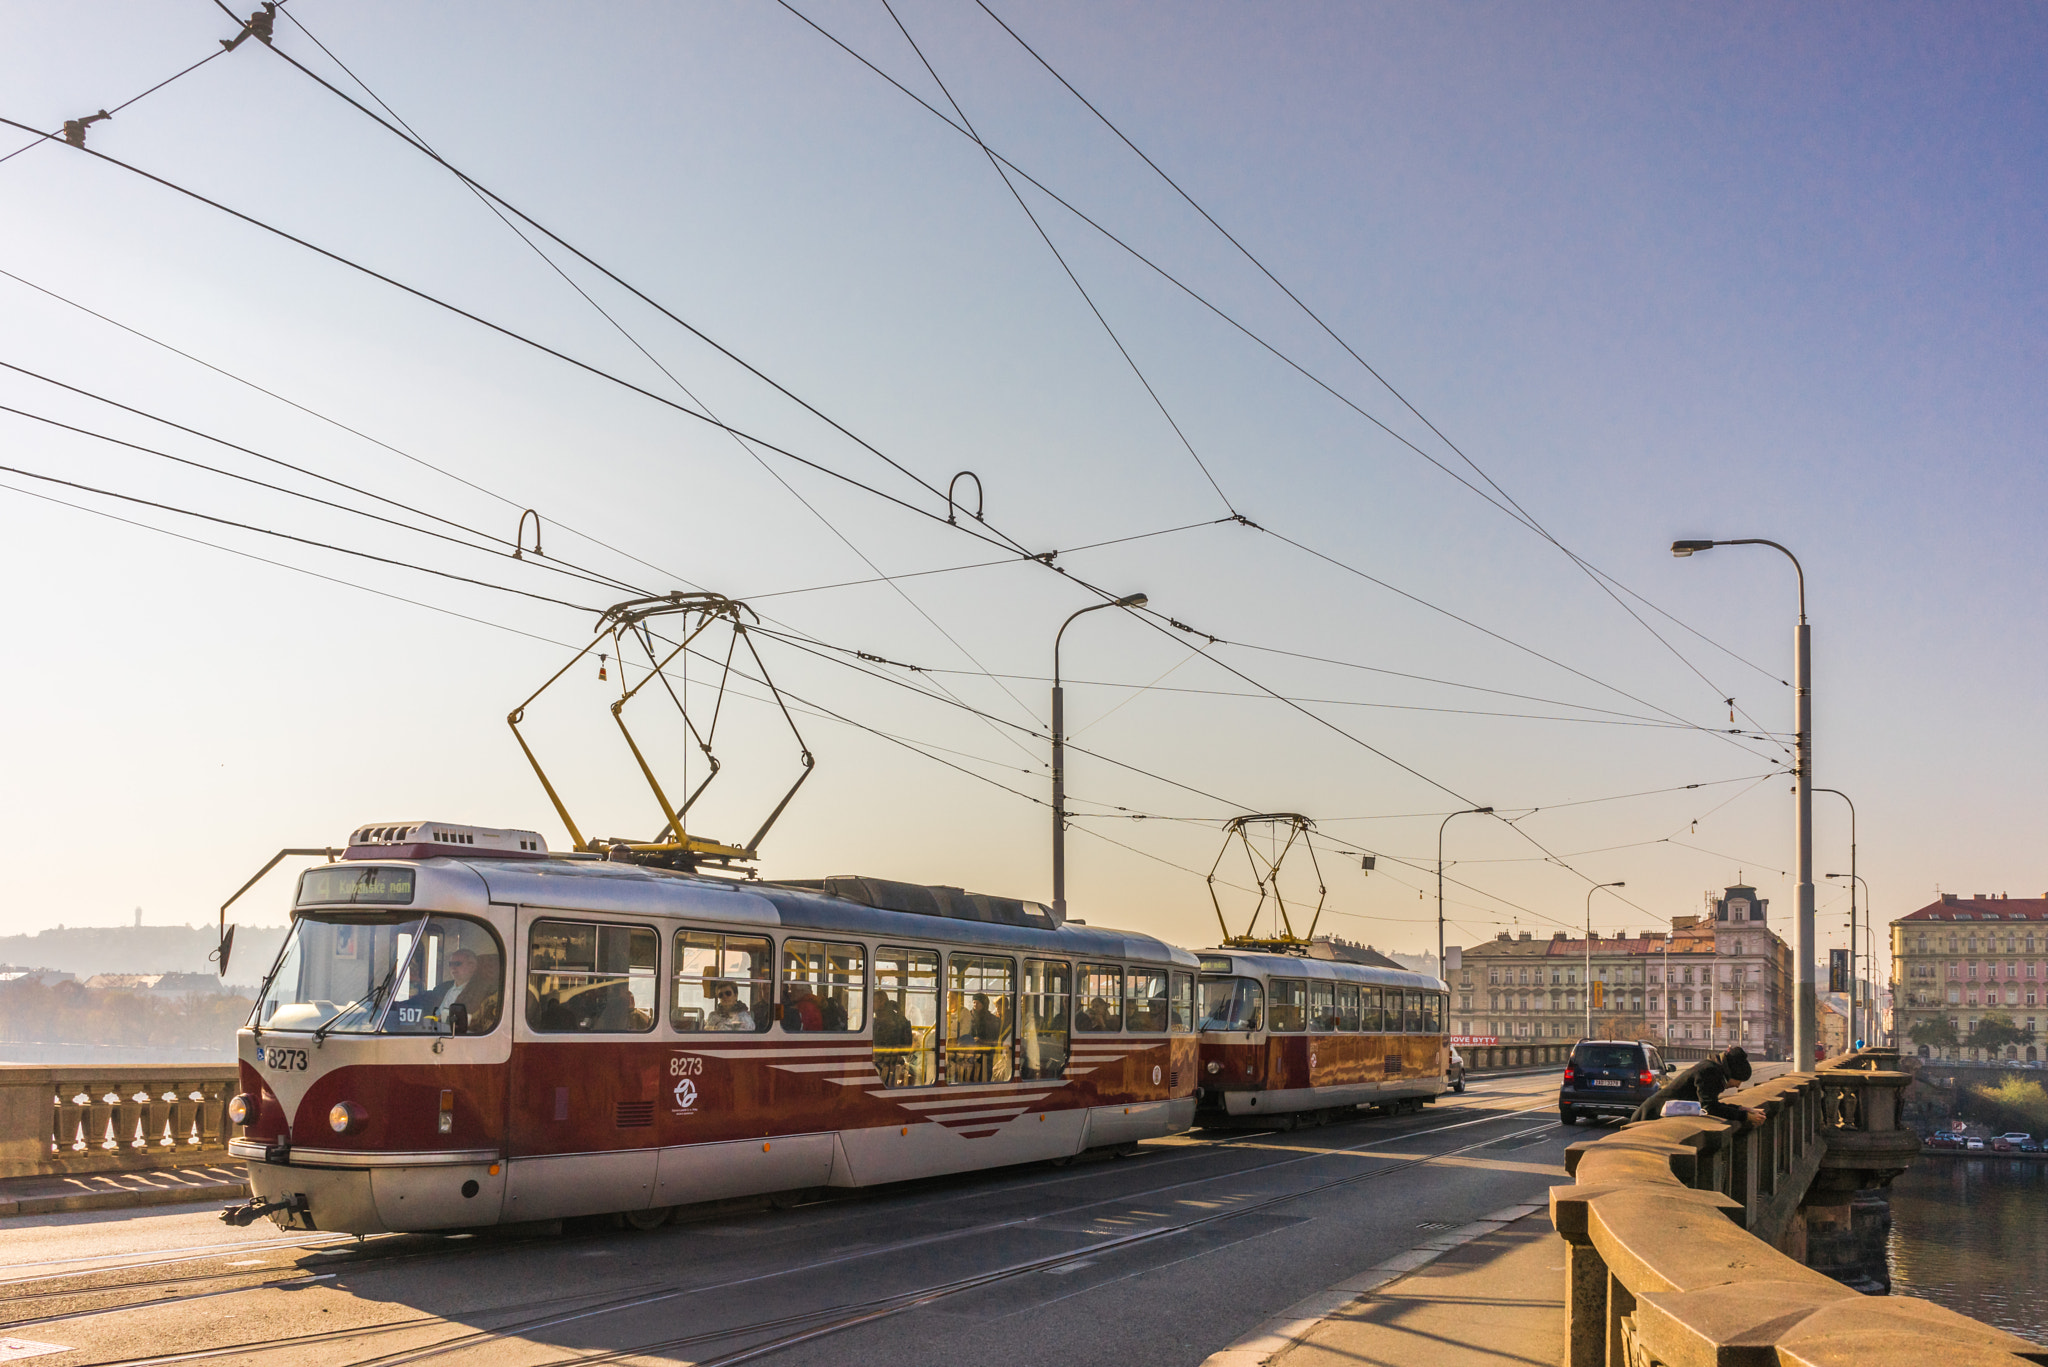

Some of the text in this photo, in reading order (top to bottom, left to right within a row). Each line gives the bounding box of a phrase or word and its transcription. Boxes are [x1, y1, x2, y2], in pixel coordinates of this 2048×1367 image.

[317, 874, 330, 900] 4
[399, 1008, 422, 1023] 507
[268, 1048, 308, 1071] 8273
[670, 1057, 703, 1076] 8273
